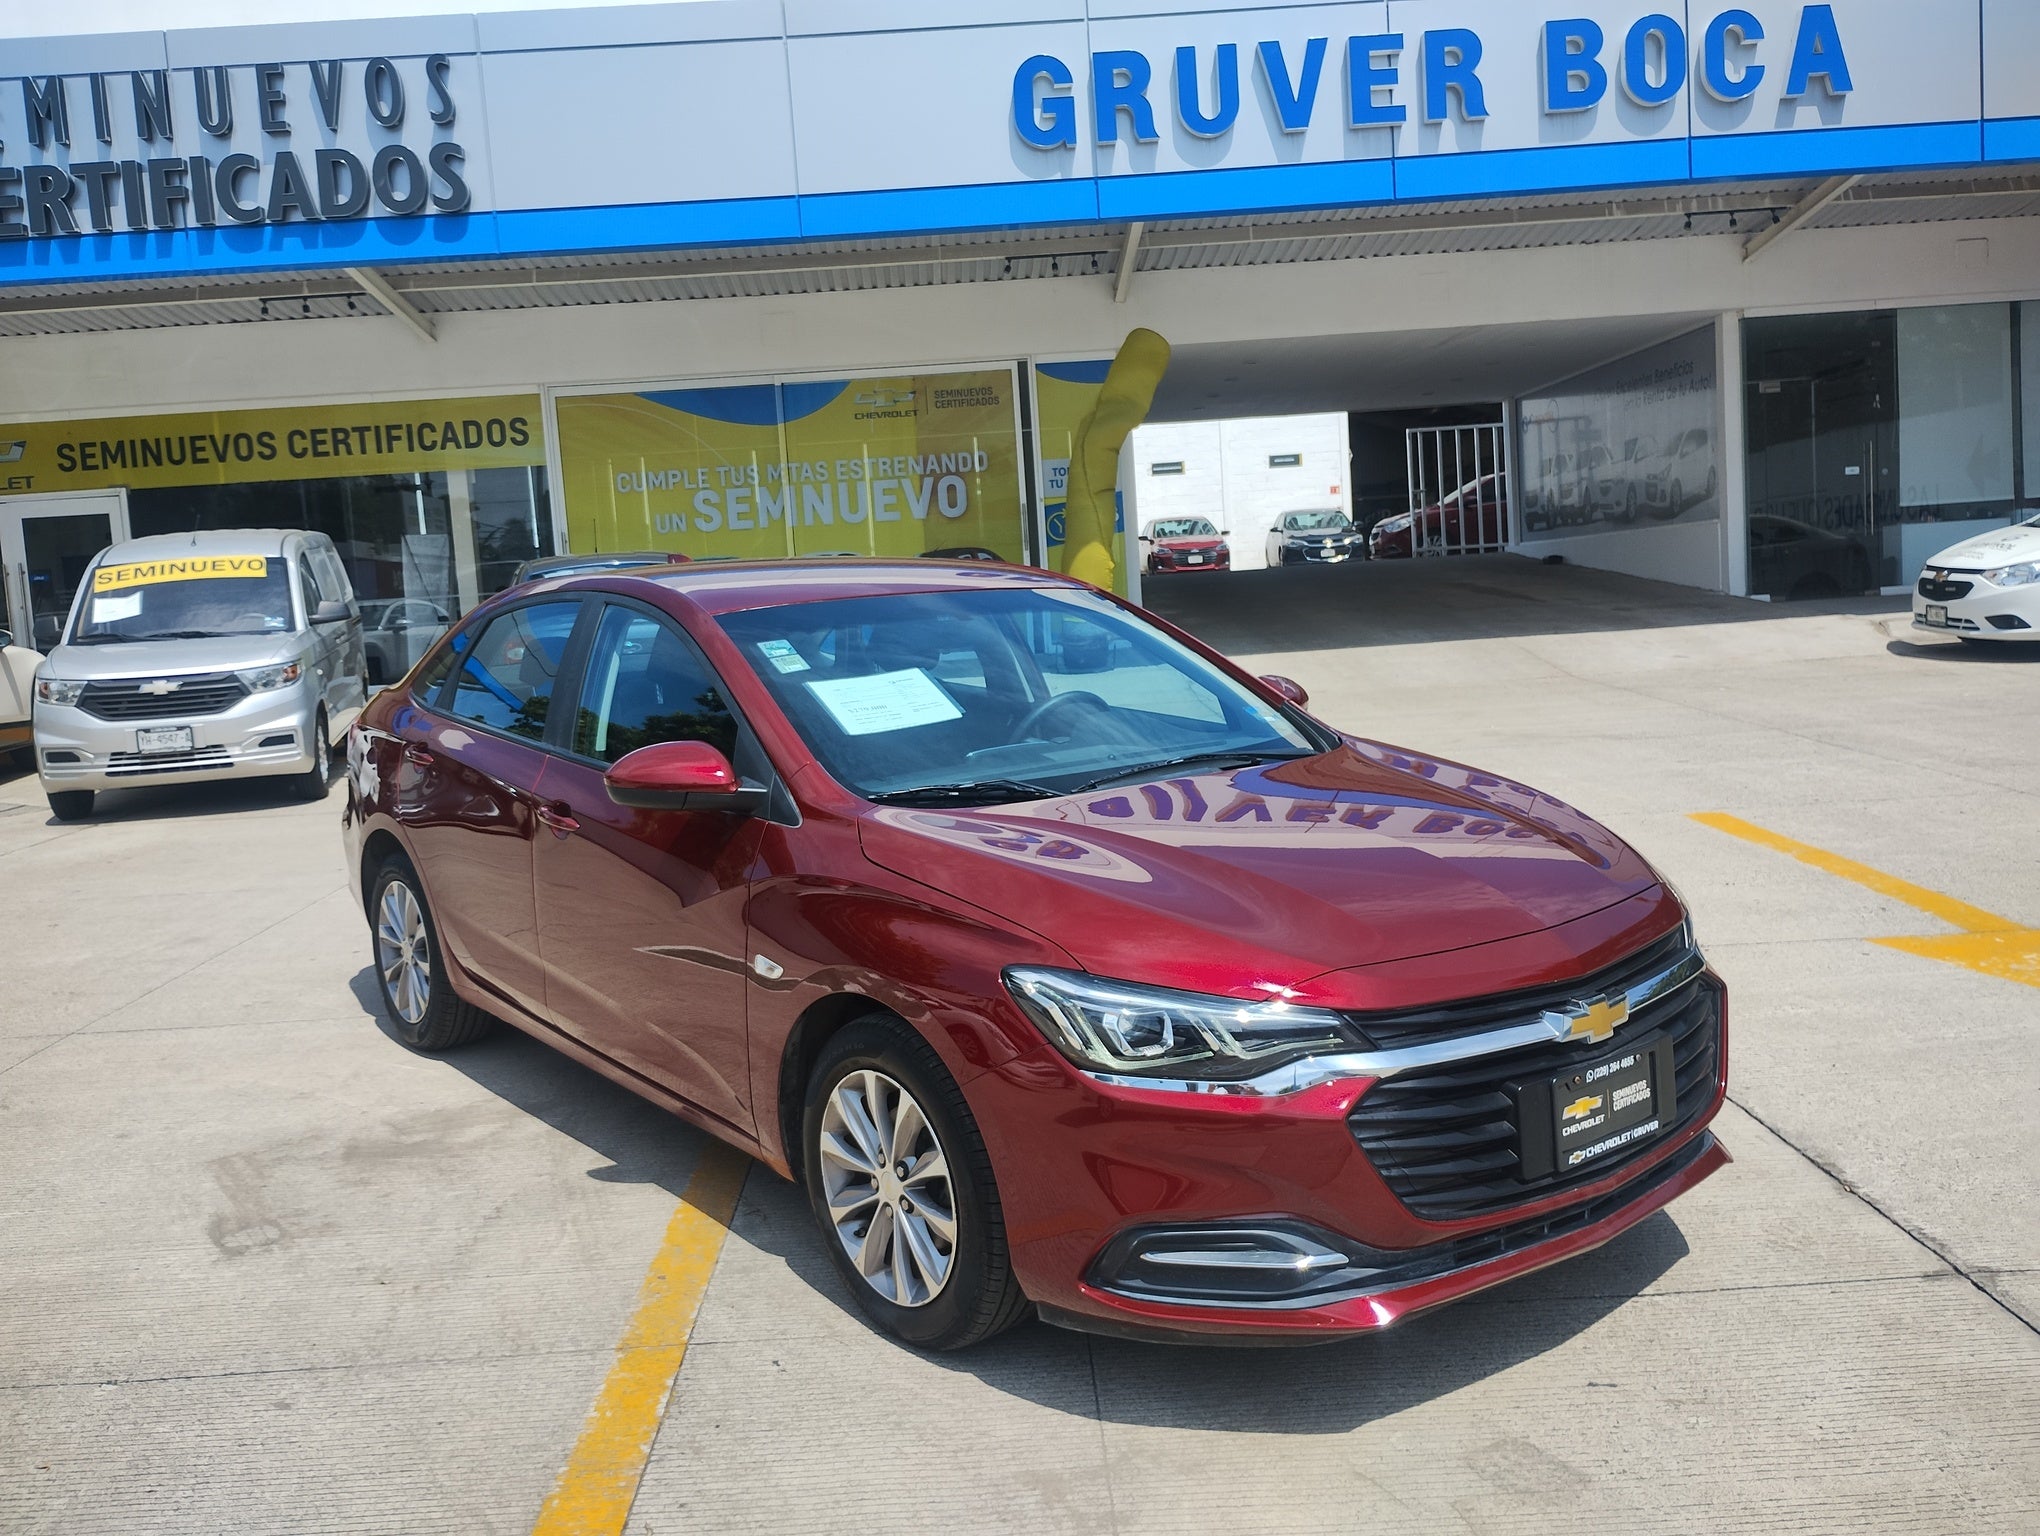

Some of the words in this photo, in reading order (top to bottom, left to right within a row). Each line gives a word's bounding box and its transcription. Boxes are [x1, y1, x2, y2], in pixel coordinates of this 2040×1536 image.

[1013, 29, 1489, 149] GRUVER
[1546, 4, 1852, 113] BOCA
[0, 54, 455, 146] MINUEVOS
[934, 386, 993, 400] SEMINUEVOS
[935, 396, 1000, 409] CERTIFICADOS
[854, 409, 919, 420] CHEVROLET
[57, 431, 277, 472] SEMINUEVOS
[288, 417, 530, 459] CERTIFICADOS
[617, 468, 709, 493] CUMPLE
[716, 465, 760, 487] TUS
[835, 450, 988, 481] ESTRENANDO
[1052, 467, 1070, 477] TO
[1049, 479, 1064, 489] TU
[655, 512, 687, 534] UN
[98, 559, 264, 585] SEMINUEVO
[1612, 1079, 1647, 1101] SEMINUEVOS
[1613, 1087, 1651, 1111] CERTIFICADOS
[1562, 1114, 1605, 1137] CHEVROLET
[1586, 1131, 1631, 1157] CHEVROLET
